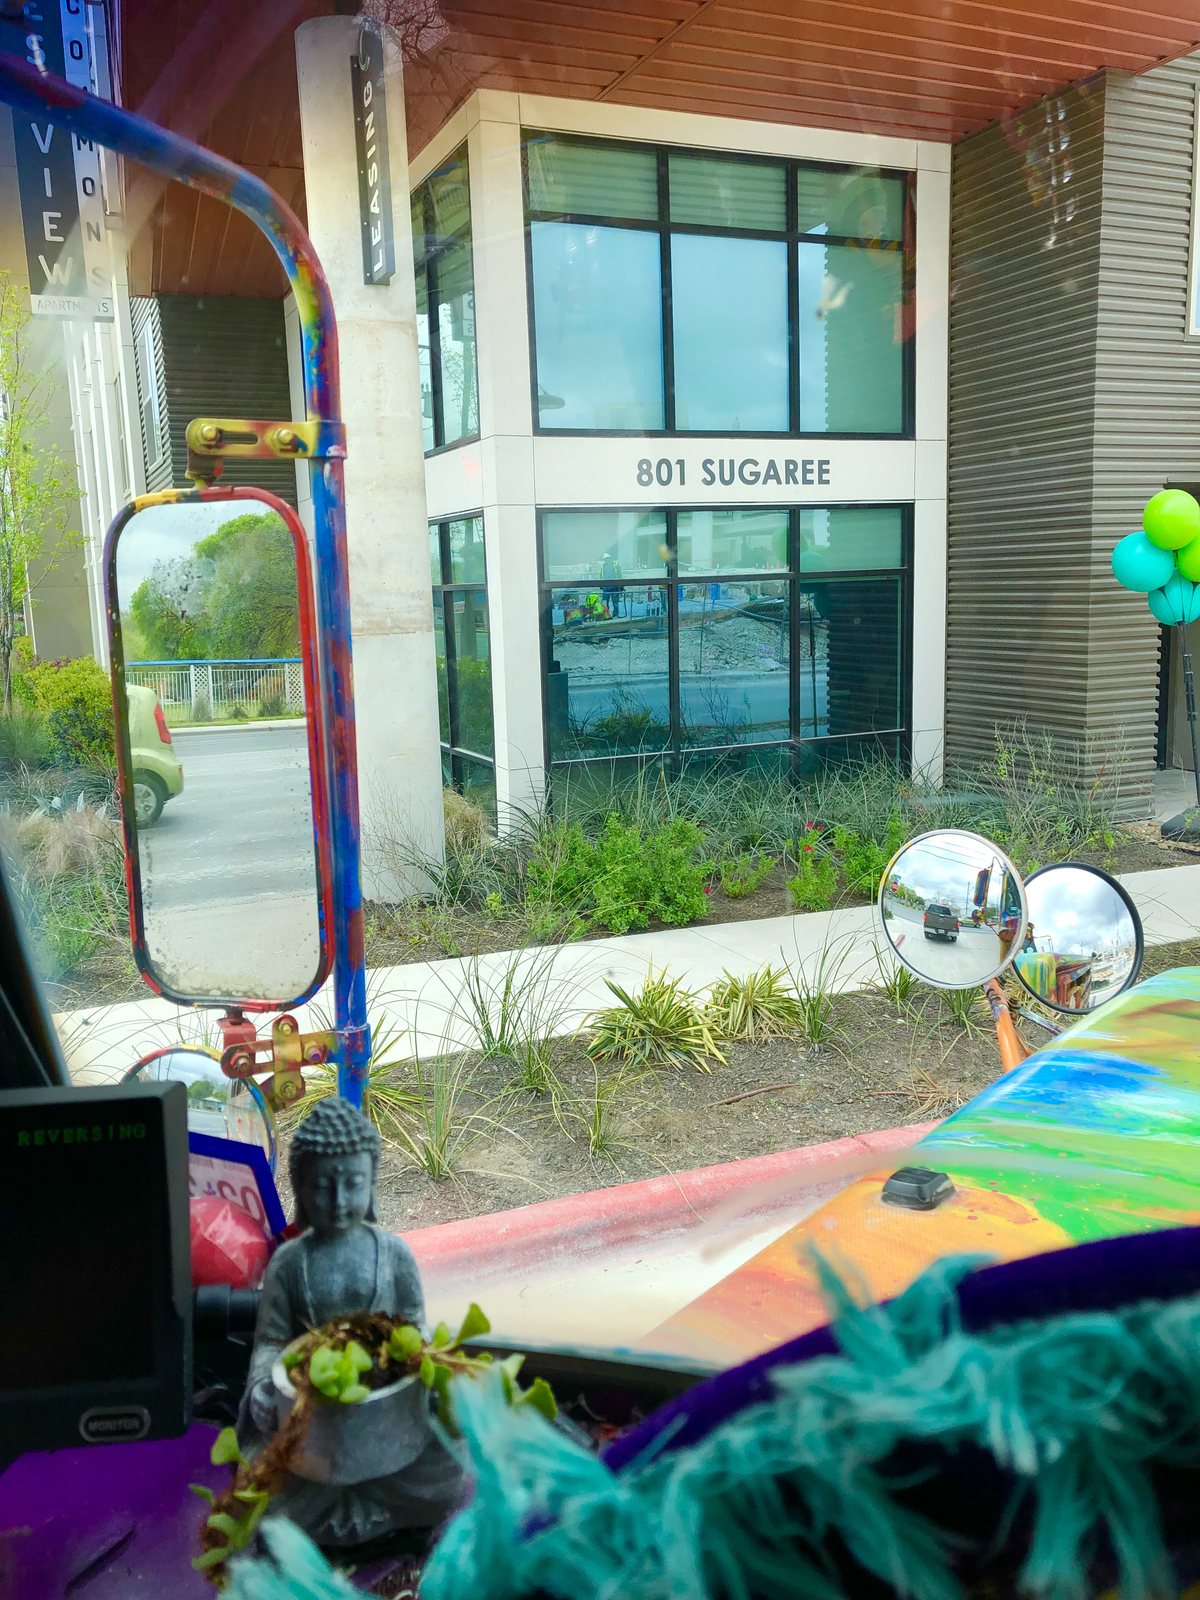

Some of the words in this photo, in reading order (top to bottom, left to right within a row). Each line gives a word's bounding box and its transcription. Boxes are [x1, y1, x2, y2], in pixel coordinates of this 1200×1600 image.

[66, 0, 107, 287] COMONS
[363, 80, 383, 273] LEASING
[636, 458, 686, 487] 801
[701, 458, 831, 486] SUGAREE
[17, 1123, 147, 1146] REVERSING
